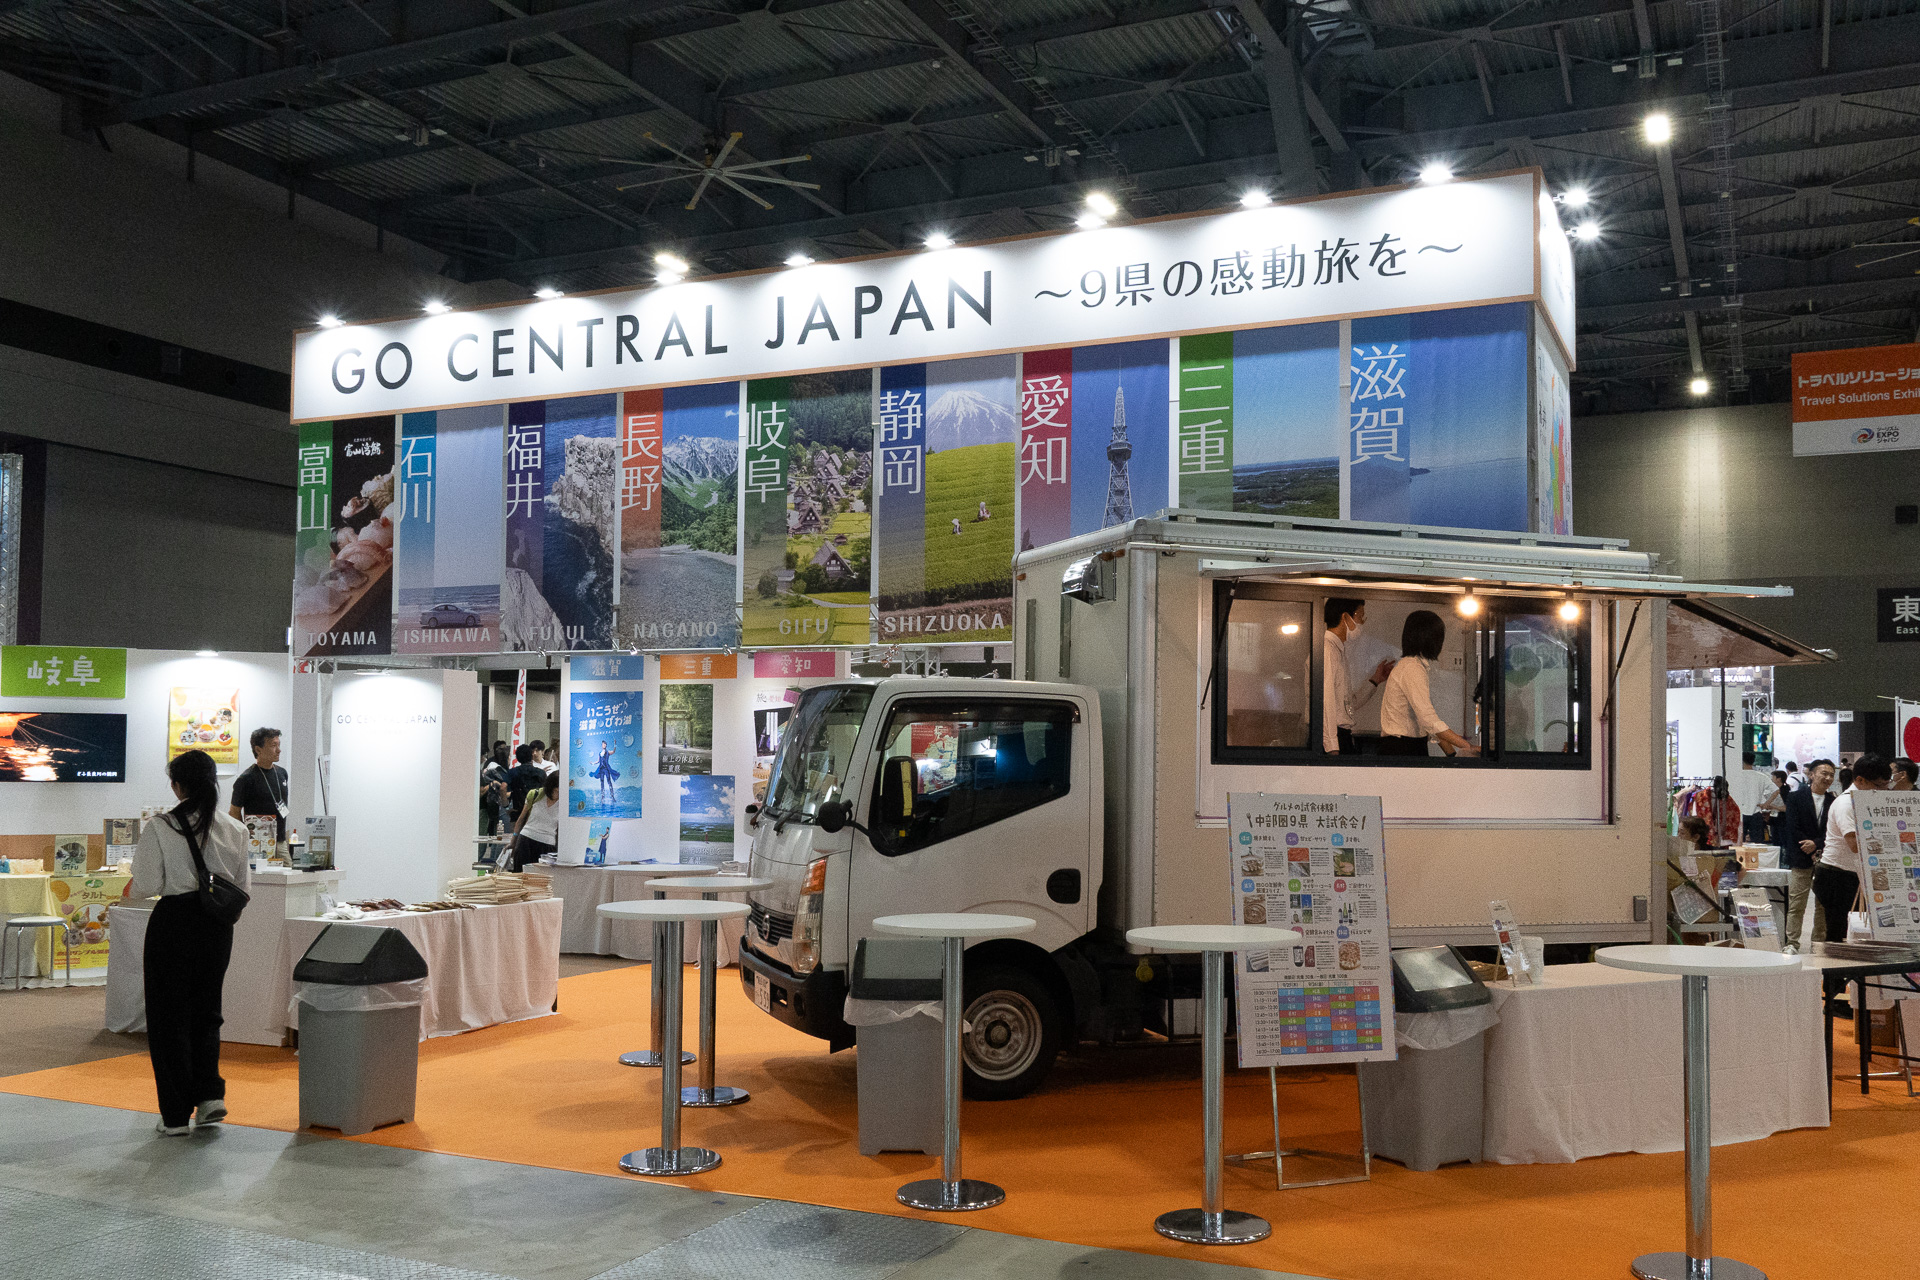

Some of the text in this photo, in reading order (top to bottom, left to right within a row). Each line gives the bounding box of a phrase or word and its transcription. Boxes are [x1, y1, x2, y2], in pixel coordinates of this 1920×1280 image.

[331, 270, 992, 395] GO CENTRAL JAPAN
[1350, 343, 1406, 465] 滋賀
[1800, 394, 1836, 407] Travel
[1838, 391, 1890, 404] Solutions
[1021, 374, 1069, 486] 愛知
[1179, 364, 1230, 475] 三重
[879, 389, 923, 497] 静岡
[1876, 430, 1899, 439] EXPO
[621, 414, 661, 511] 長野
[744, 401, 787, 503] 岐阜
[400, 435, 436, 523] 石川
[506, 424, 544, 519] 福井
[297, 442, 330, 532] 富山
[527, 624, 586, 642] FUKUI
[634, 621, 718, 639] NAGANO
[778, 618, 829, 635] GIFU
[884, 612, 1005, 634] SHIZUOKA
[1895, 625, 1920, 635] East
[307, 630, 377, 647] TOYAMA
[403, 627, 491, 645] ISHIKAWA
[26, 655, 101, 687] 岐阜
[591, 658, 622, 677] 滋賀
[684, 656, 713, 677] 三重
[780, 654, 812, 675] 愛知
[336, 714, 437, 725] GO CENRAL JAPAN
[1719, 708, 1736, 749] 歴史
[1255, 814, 1359, 829] 中部圏9県 大試食会
